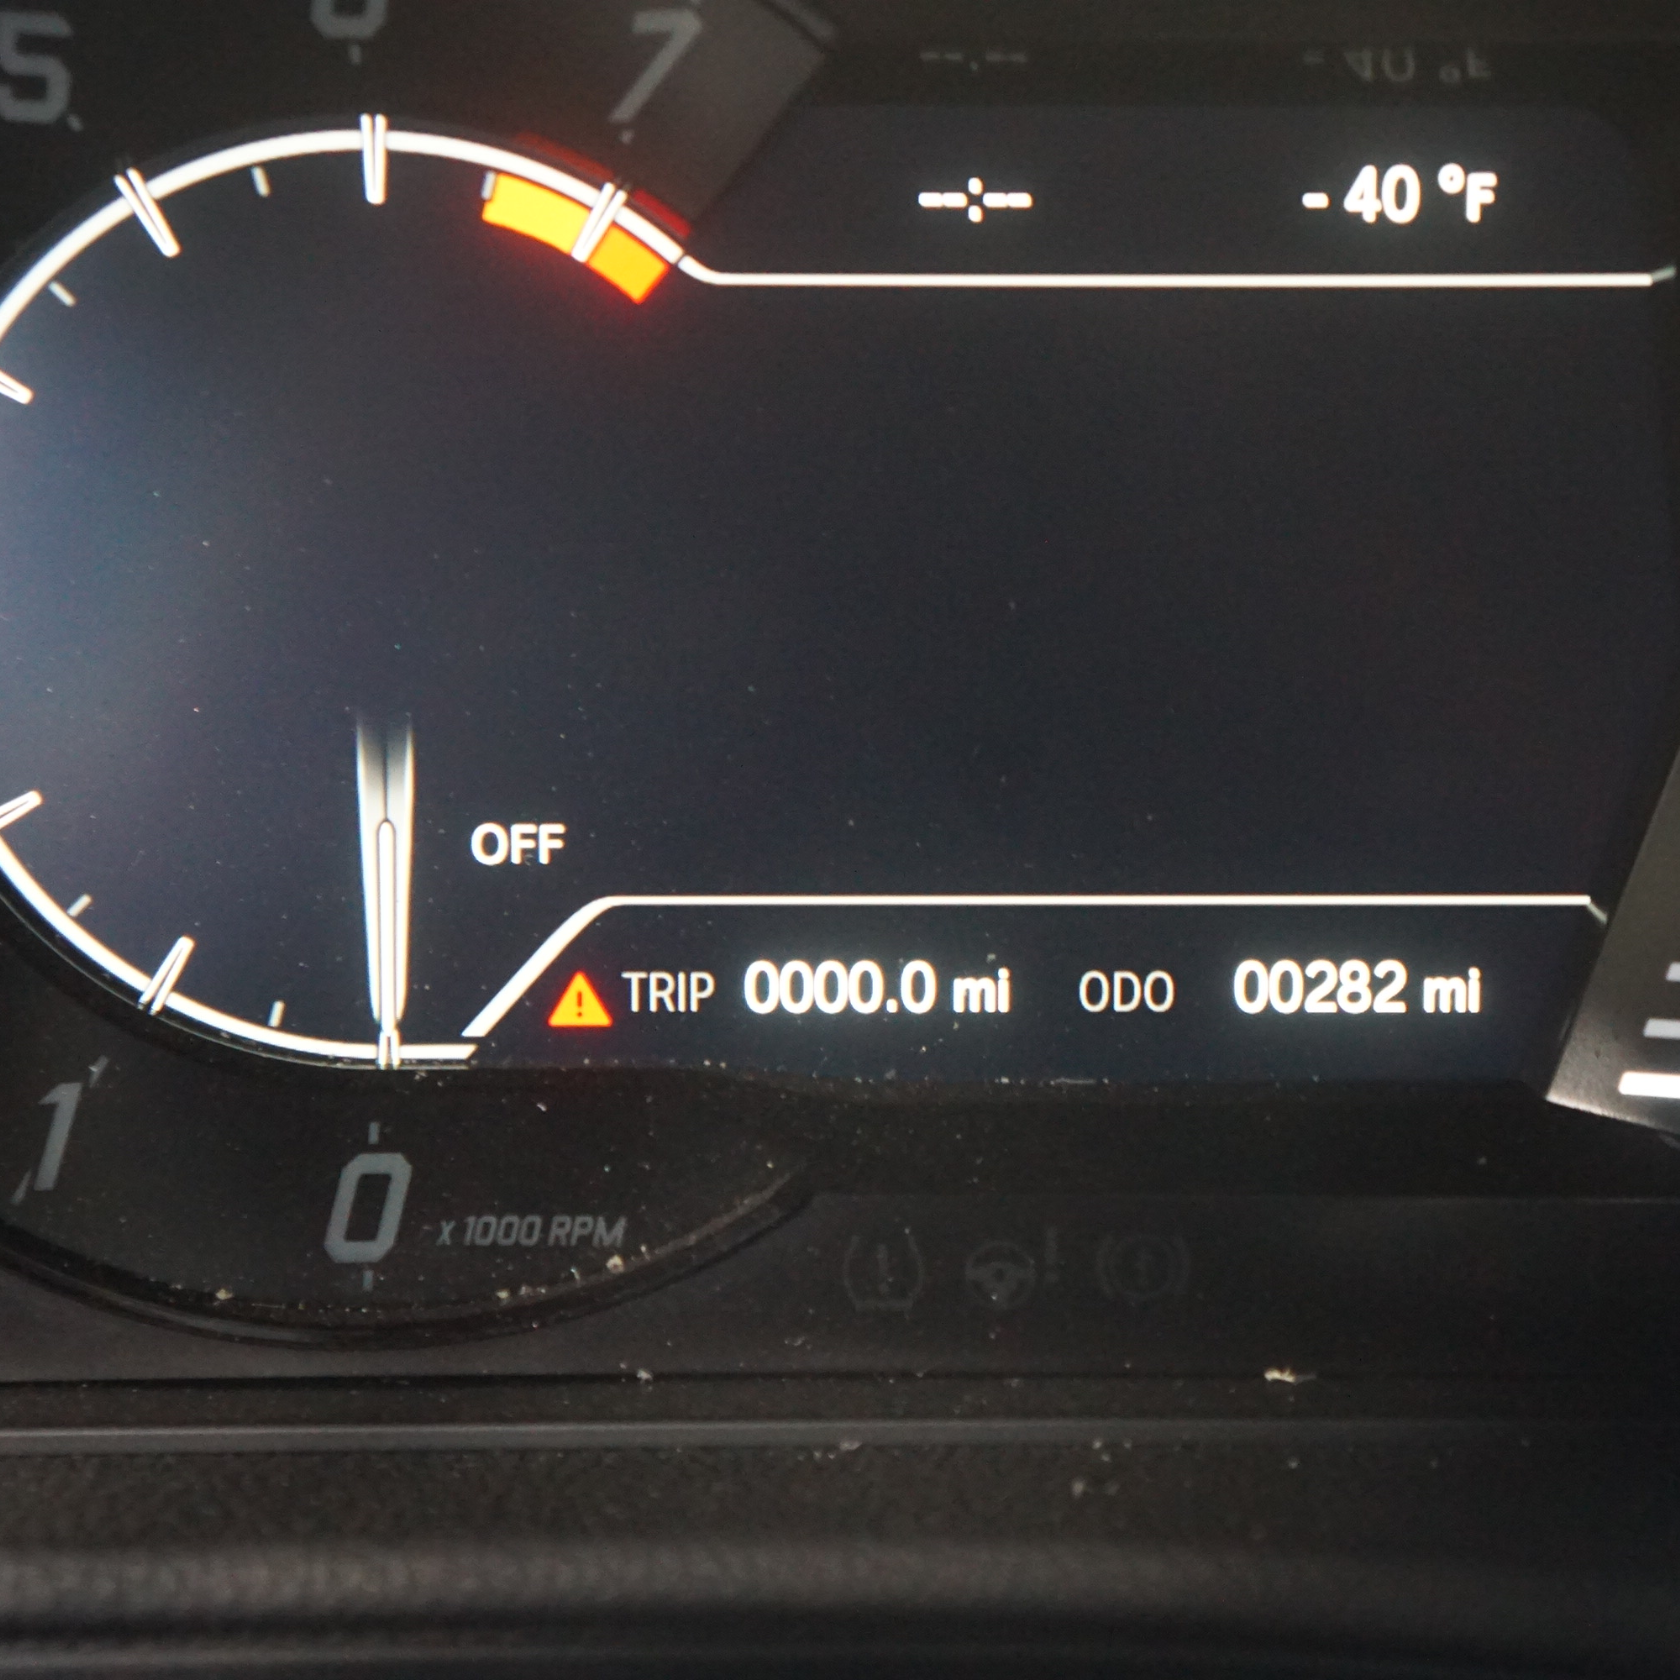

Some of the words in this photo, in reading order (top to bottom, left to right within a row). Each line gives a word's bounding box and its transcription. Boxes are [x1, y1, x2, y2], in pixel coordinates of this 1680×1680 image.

[610, 8, 704, 122] 7
[471, 823, 565, 866] OFF
[622, 972, 714, 1012] TRIP
[744, 959, 937, 1014] 0000.0
[953, 968, 1010, 1013] mi
[1080, 971, 1173, 1012] ODO
[1234, 959, 1407, 1014] 00282
[1423, 967, 1480, 1013] mi
[37, 1082, 82, 1190] 1
[324, 1153, 412, 1263] 0
[463, 1214, 542, 1246] 1000
[547, 1215, 628, 1248] RPM
